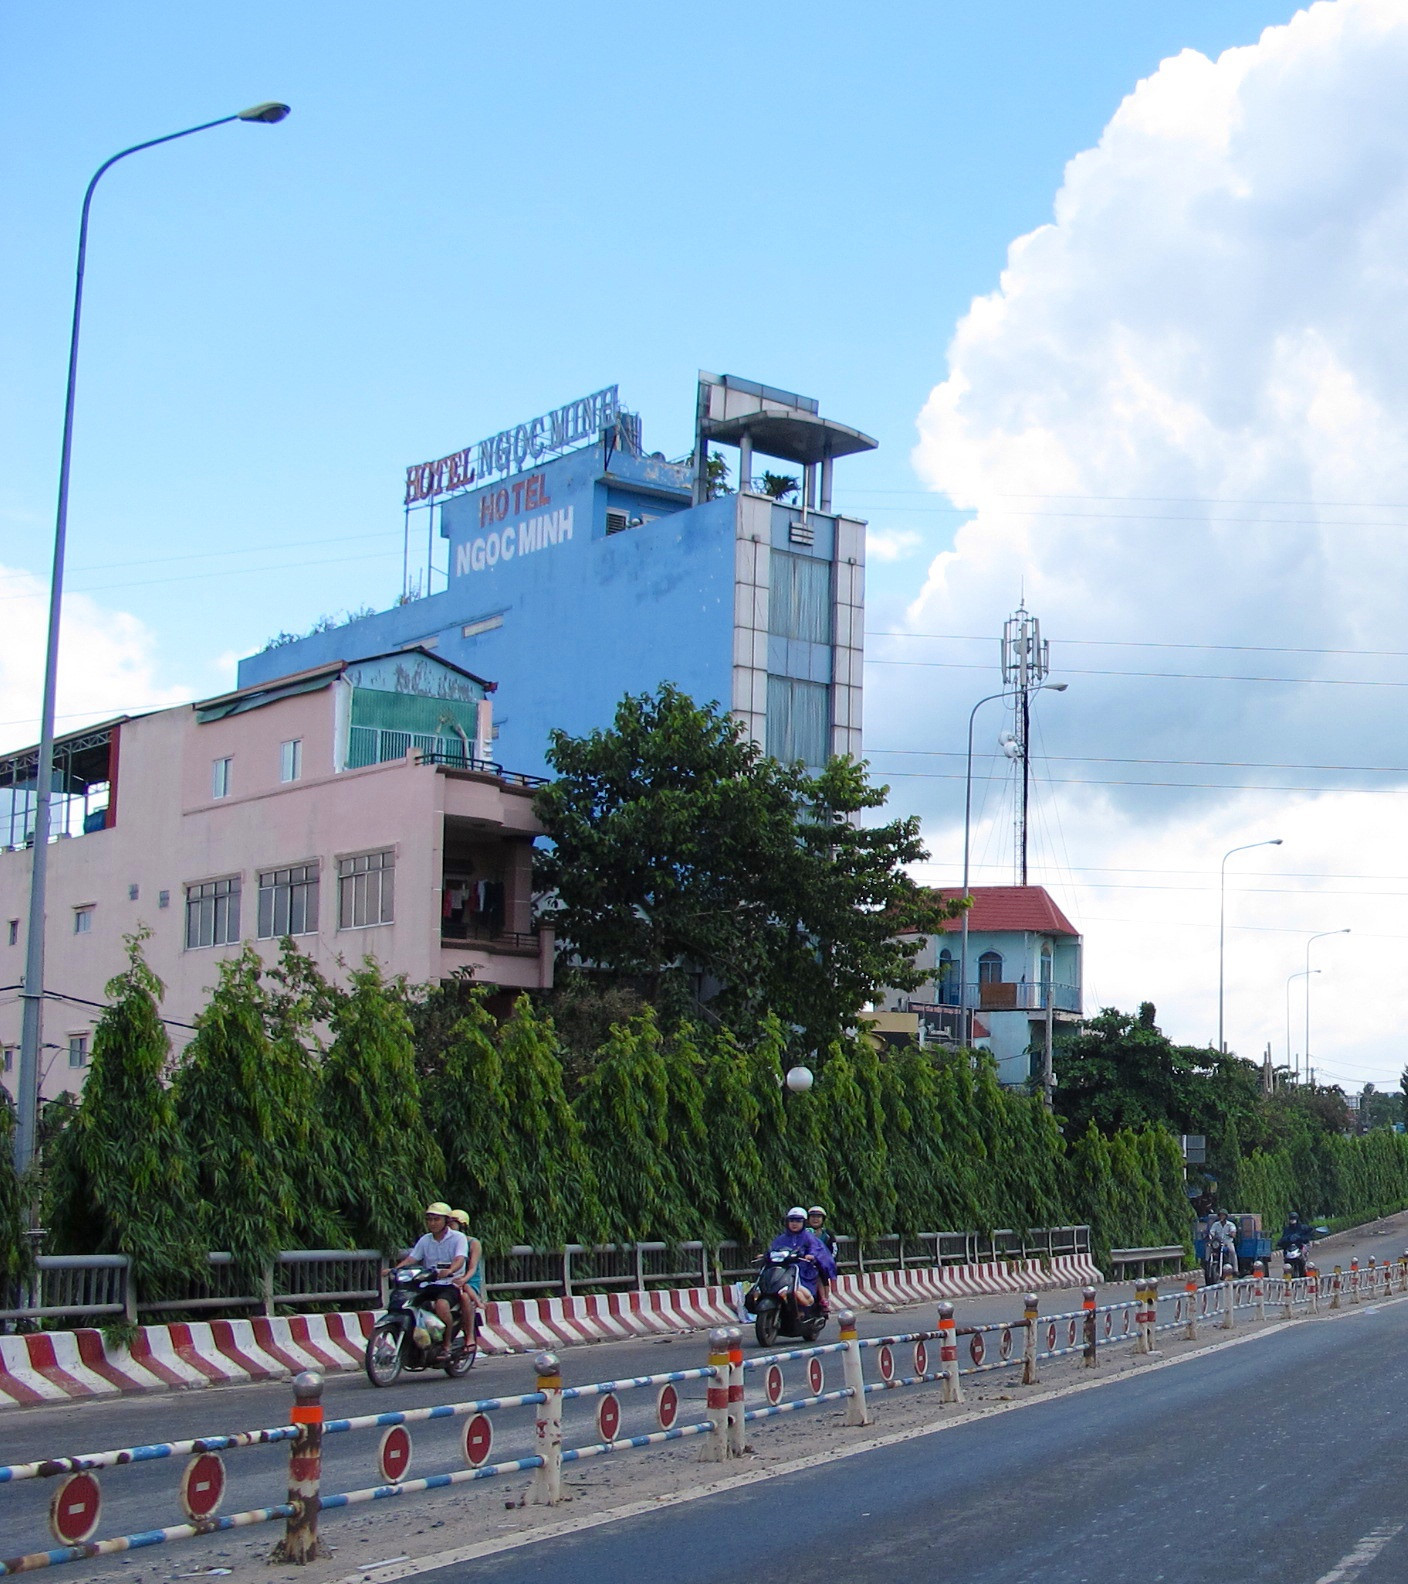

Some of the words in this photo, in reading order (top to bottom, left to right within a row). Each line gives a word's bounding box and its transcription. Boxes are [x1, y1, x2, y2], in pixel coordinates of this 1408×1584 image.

[404, 447, 475, 505] HOTEL
[546, 384, 619, 450] MINH
[480, 473, 551, 528] HOTEL
[518, 505, 574, 557] MINH
